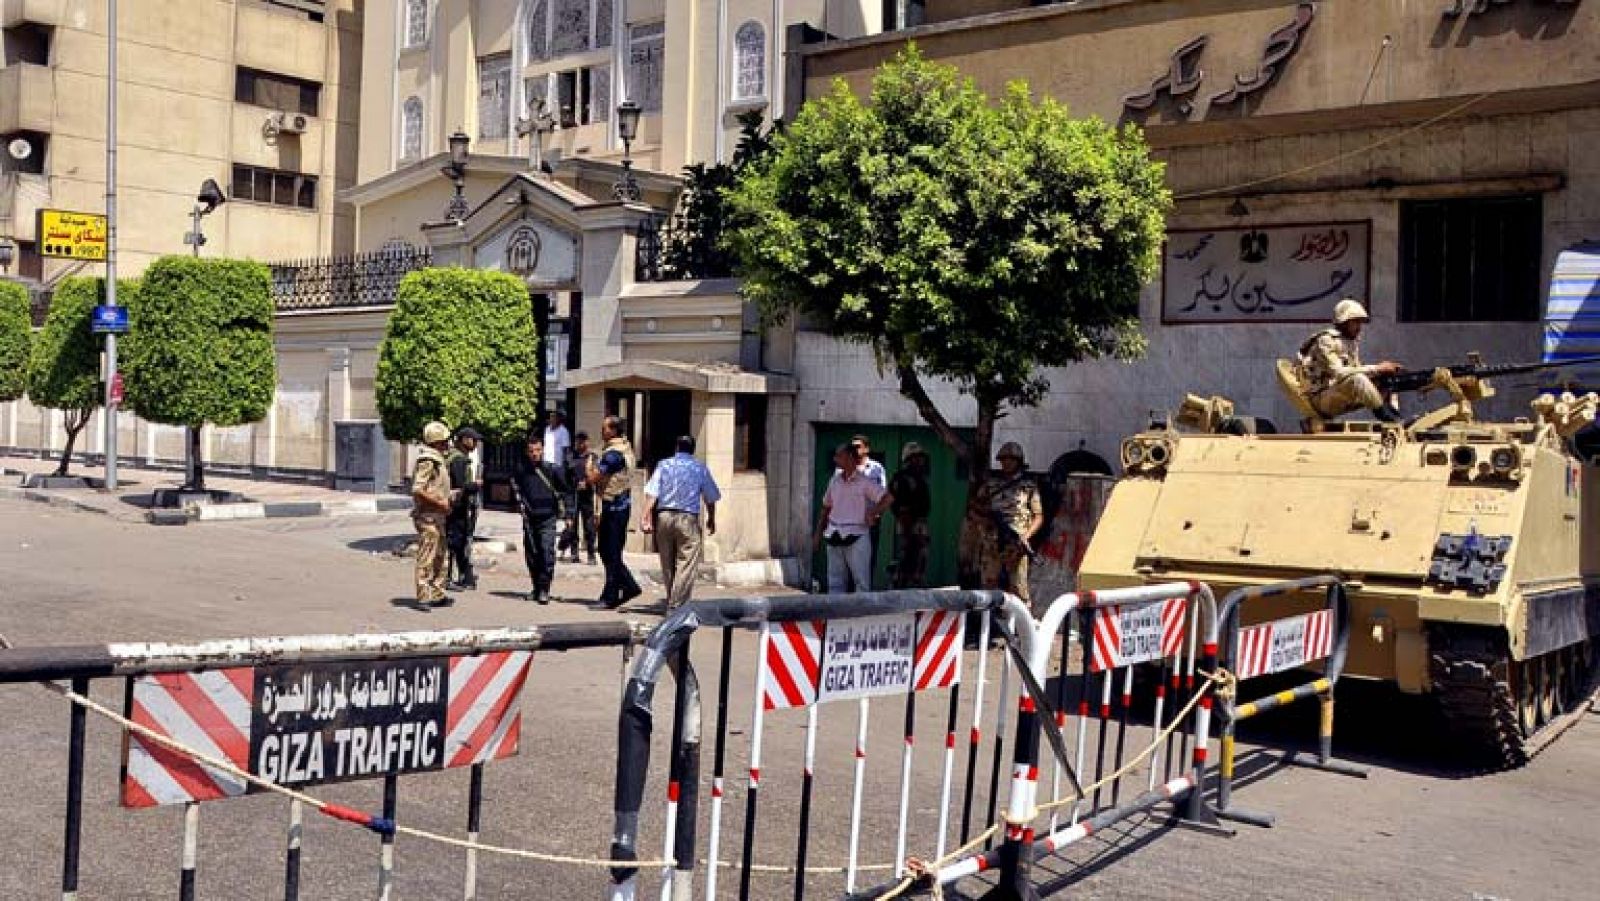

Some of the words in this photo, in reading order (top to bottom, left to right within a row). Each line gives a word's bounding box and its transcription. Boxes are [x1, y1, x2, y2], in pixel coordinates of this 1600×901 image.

[825, 664, 855, 692] GIZA
[860, 660, 909, 688] TRAFFIC
[258, 731, 324, 784] GIZA
[334, 720, 438, 776] TRAFFIC
